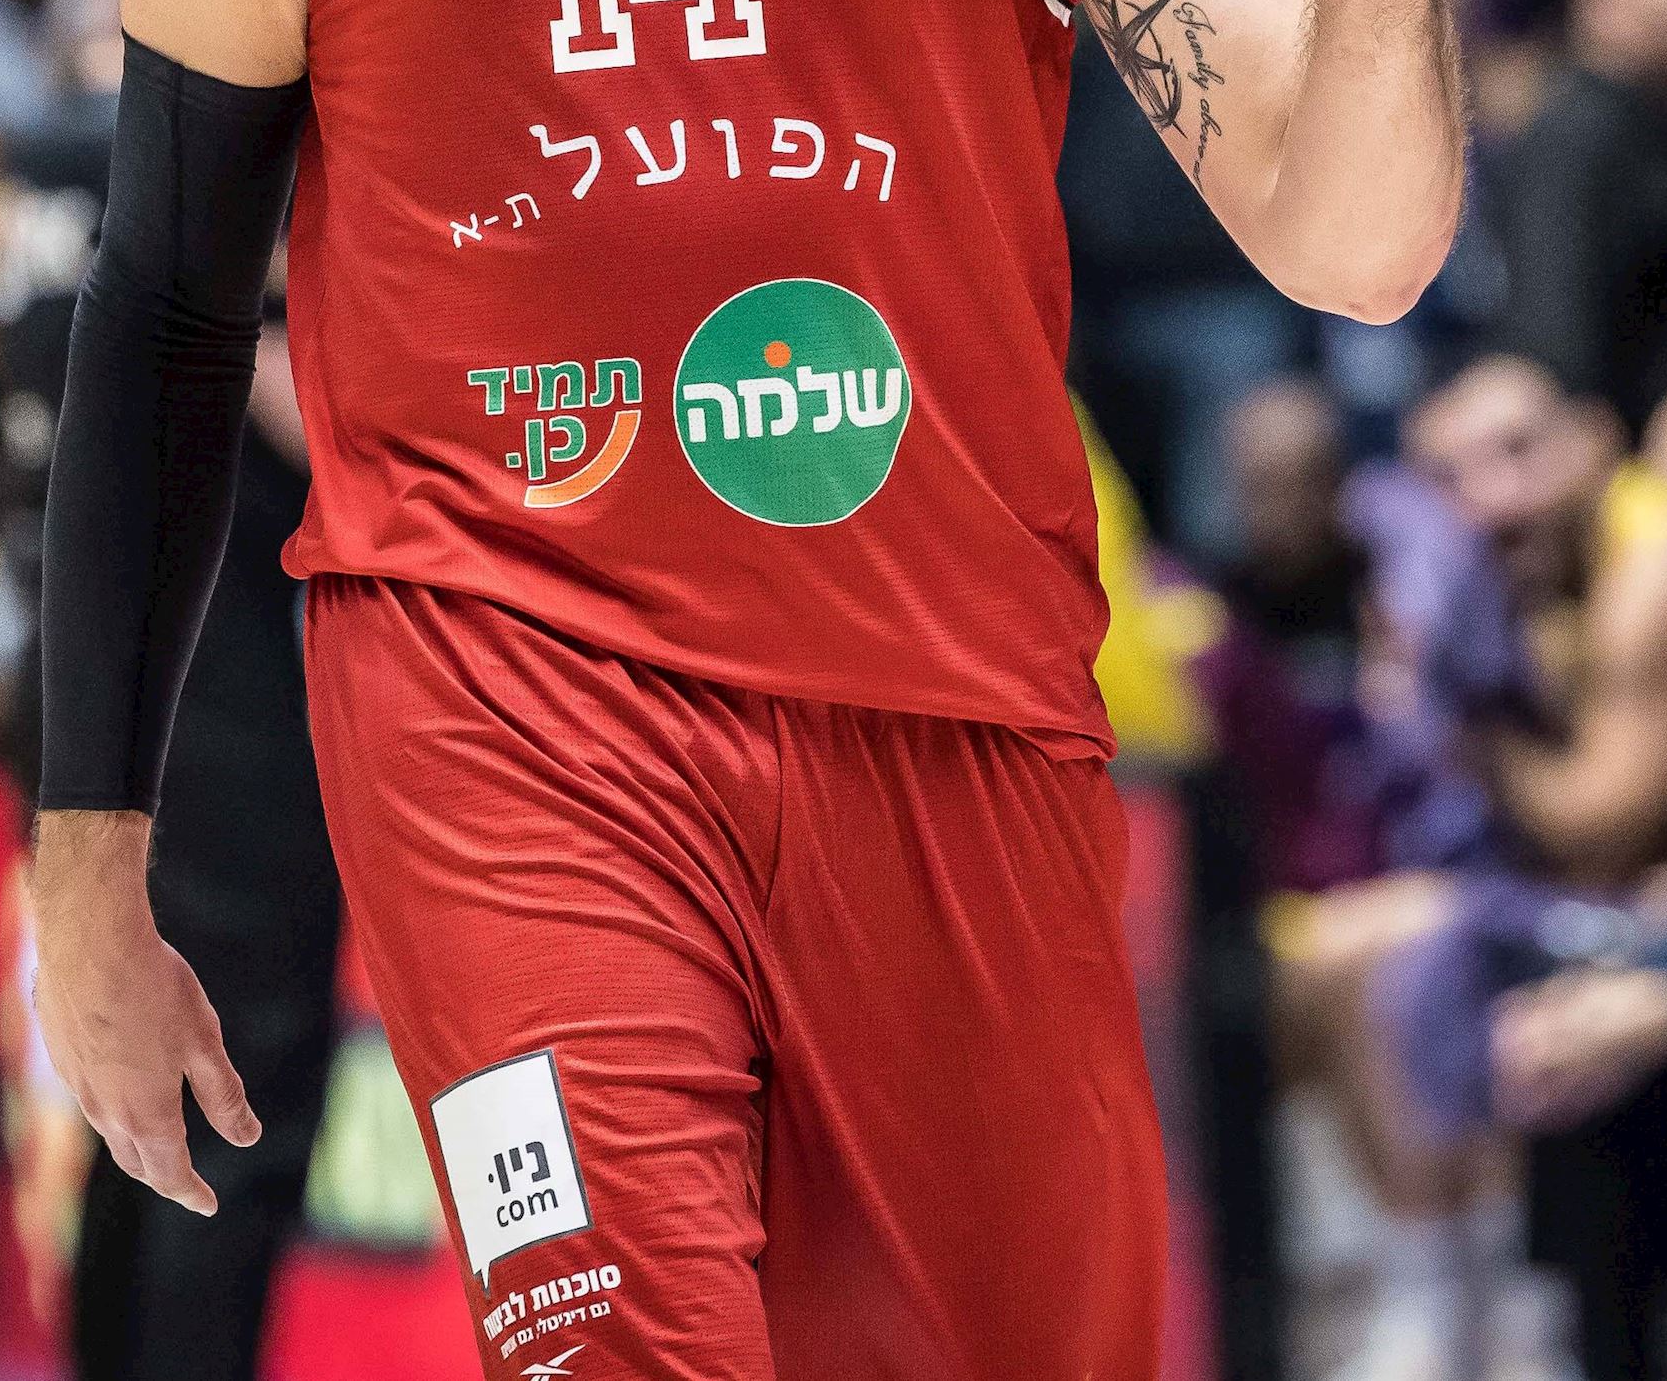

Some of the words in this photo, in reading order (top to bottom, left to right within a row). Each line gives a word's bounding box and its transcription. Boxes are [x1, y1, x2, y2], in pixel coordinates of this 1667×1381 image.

[528, 117, 897, 202] הפועל
[449, 192, 541, 249] ת-א
[467, 356, 643, 416] תמיד
[682, 365, 903, 443] שלמה
[505, 415, 588, 481] כן.
[496, 1188, 559, 1228] com
[529, 1264, 621, 1312] סוכנות
[589, 1301, 611, 1319] גם
[516, 1327, 535, 1345] גם
